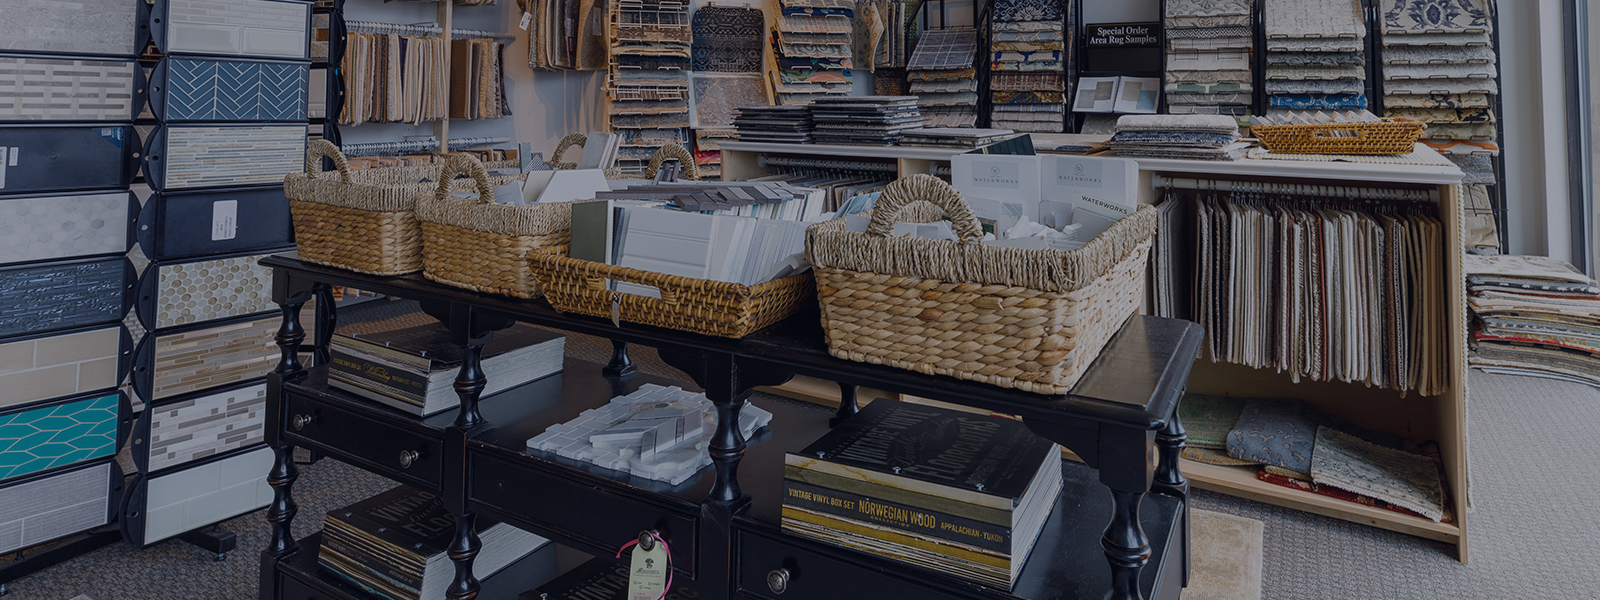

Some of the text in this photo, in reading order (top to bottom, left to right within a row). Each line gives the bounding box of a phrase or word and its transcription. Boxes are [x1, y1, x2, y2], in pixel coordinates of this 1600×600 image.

[1090, 35, 1157, 45] Area Rug Samples
[1097, 26, 1149, 37] Special Order
[1058, 175, 1101, 183] WATERWORKS
[1081, 195, 1128, 215] WATERWORKS
[837, 427, 900, 465] VINTAGE
[877, 408, 941, 430] VINYL
[902, 417, 1001, 480] FLOORCLOTHS
[370, 491, 436, 522] VINTAG
[409, 497, 444, 523] Durab
[788, 488, 812, 501] VINTAGE
[812, 493, 830, 504] VINYL
[830, 498, 842, 508] BOX
[843, 500, 855, 510] SET
[858, 500, 908, 523] NORWEGIAN
[910, 511, 936, 529] WOOD
[870, 515, 910, 528] COLLECTION
